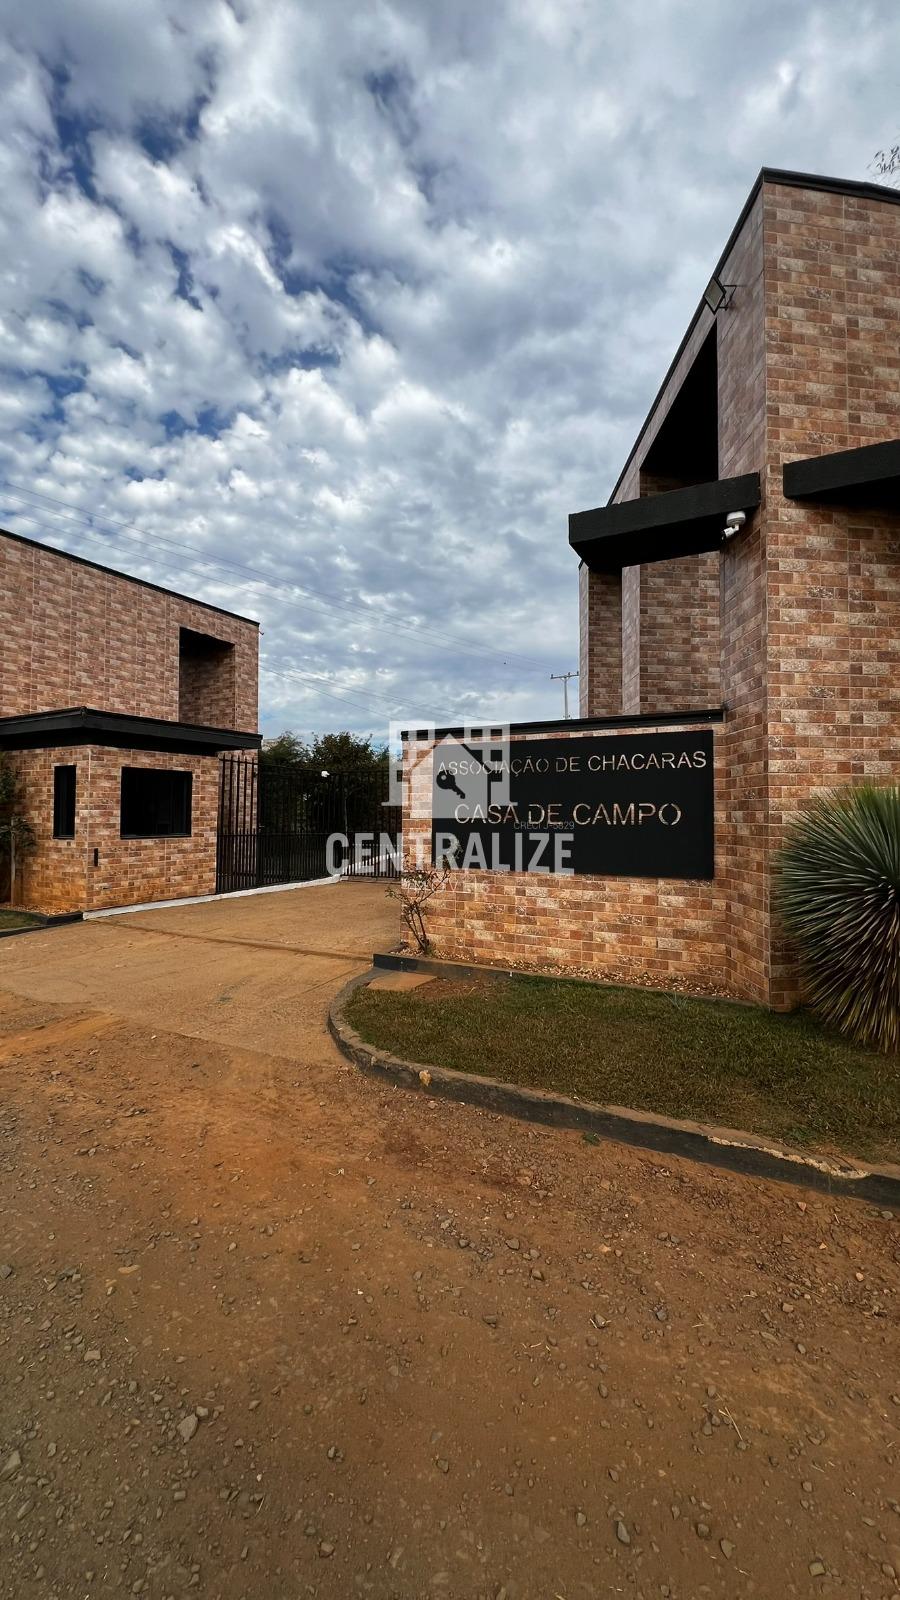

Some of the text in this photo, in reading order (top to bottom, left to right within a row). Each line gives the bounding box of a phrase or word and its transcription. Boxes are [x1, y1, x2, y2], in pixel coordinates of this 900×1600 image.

[437, 751, 708, 777] ASSOCIAÇÃO DE CHACARAS
[454, 803, 682, 826] CASA DE CAMPO
